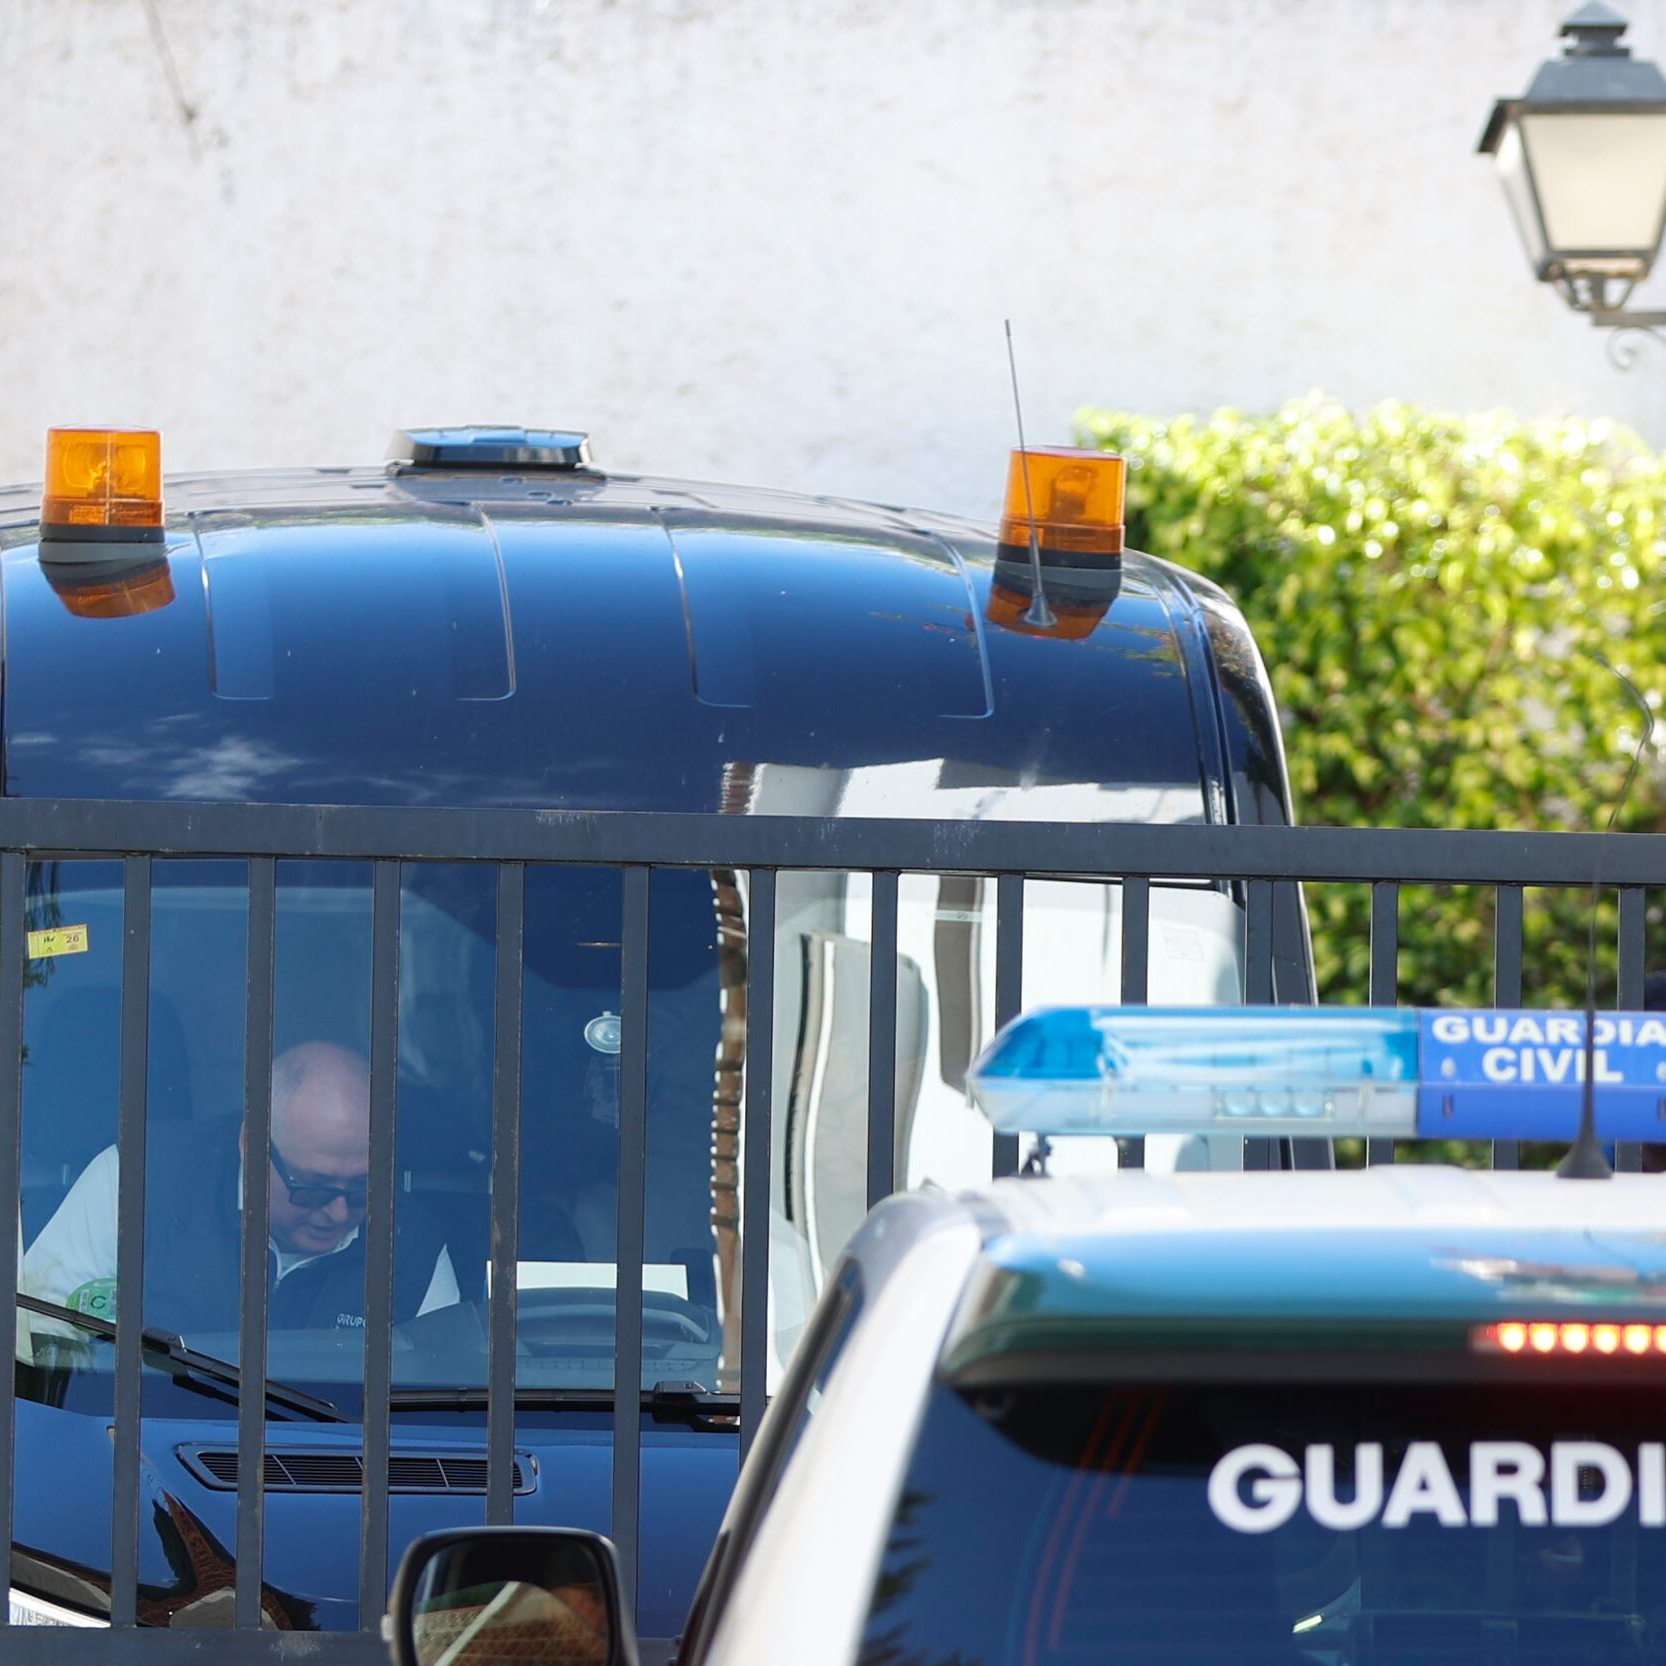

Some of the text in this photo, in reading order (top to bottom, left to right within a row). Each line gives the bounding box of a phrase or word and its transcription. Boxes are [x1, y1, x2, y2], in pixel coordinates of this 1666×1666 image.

[1482, 1047, 1625, 1083] CIVIL
[90, 1295, 108, 1310] C
[337, 1312, 365, 1328] GRUP
